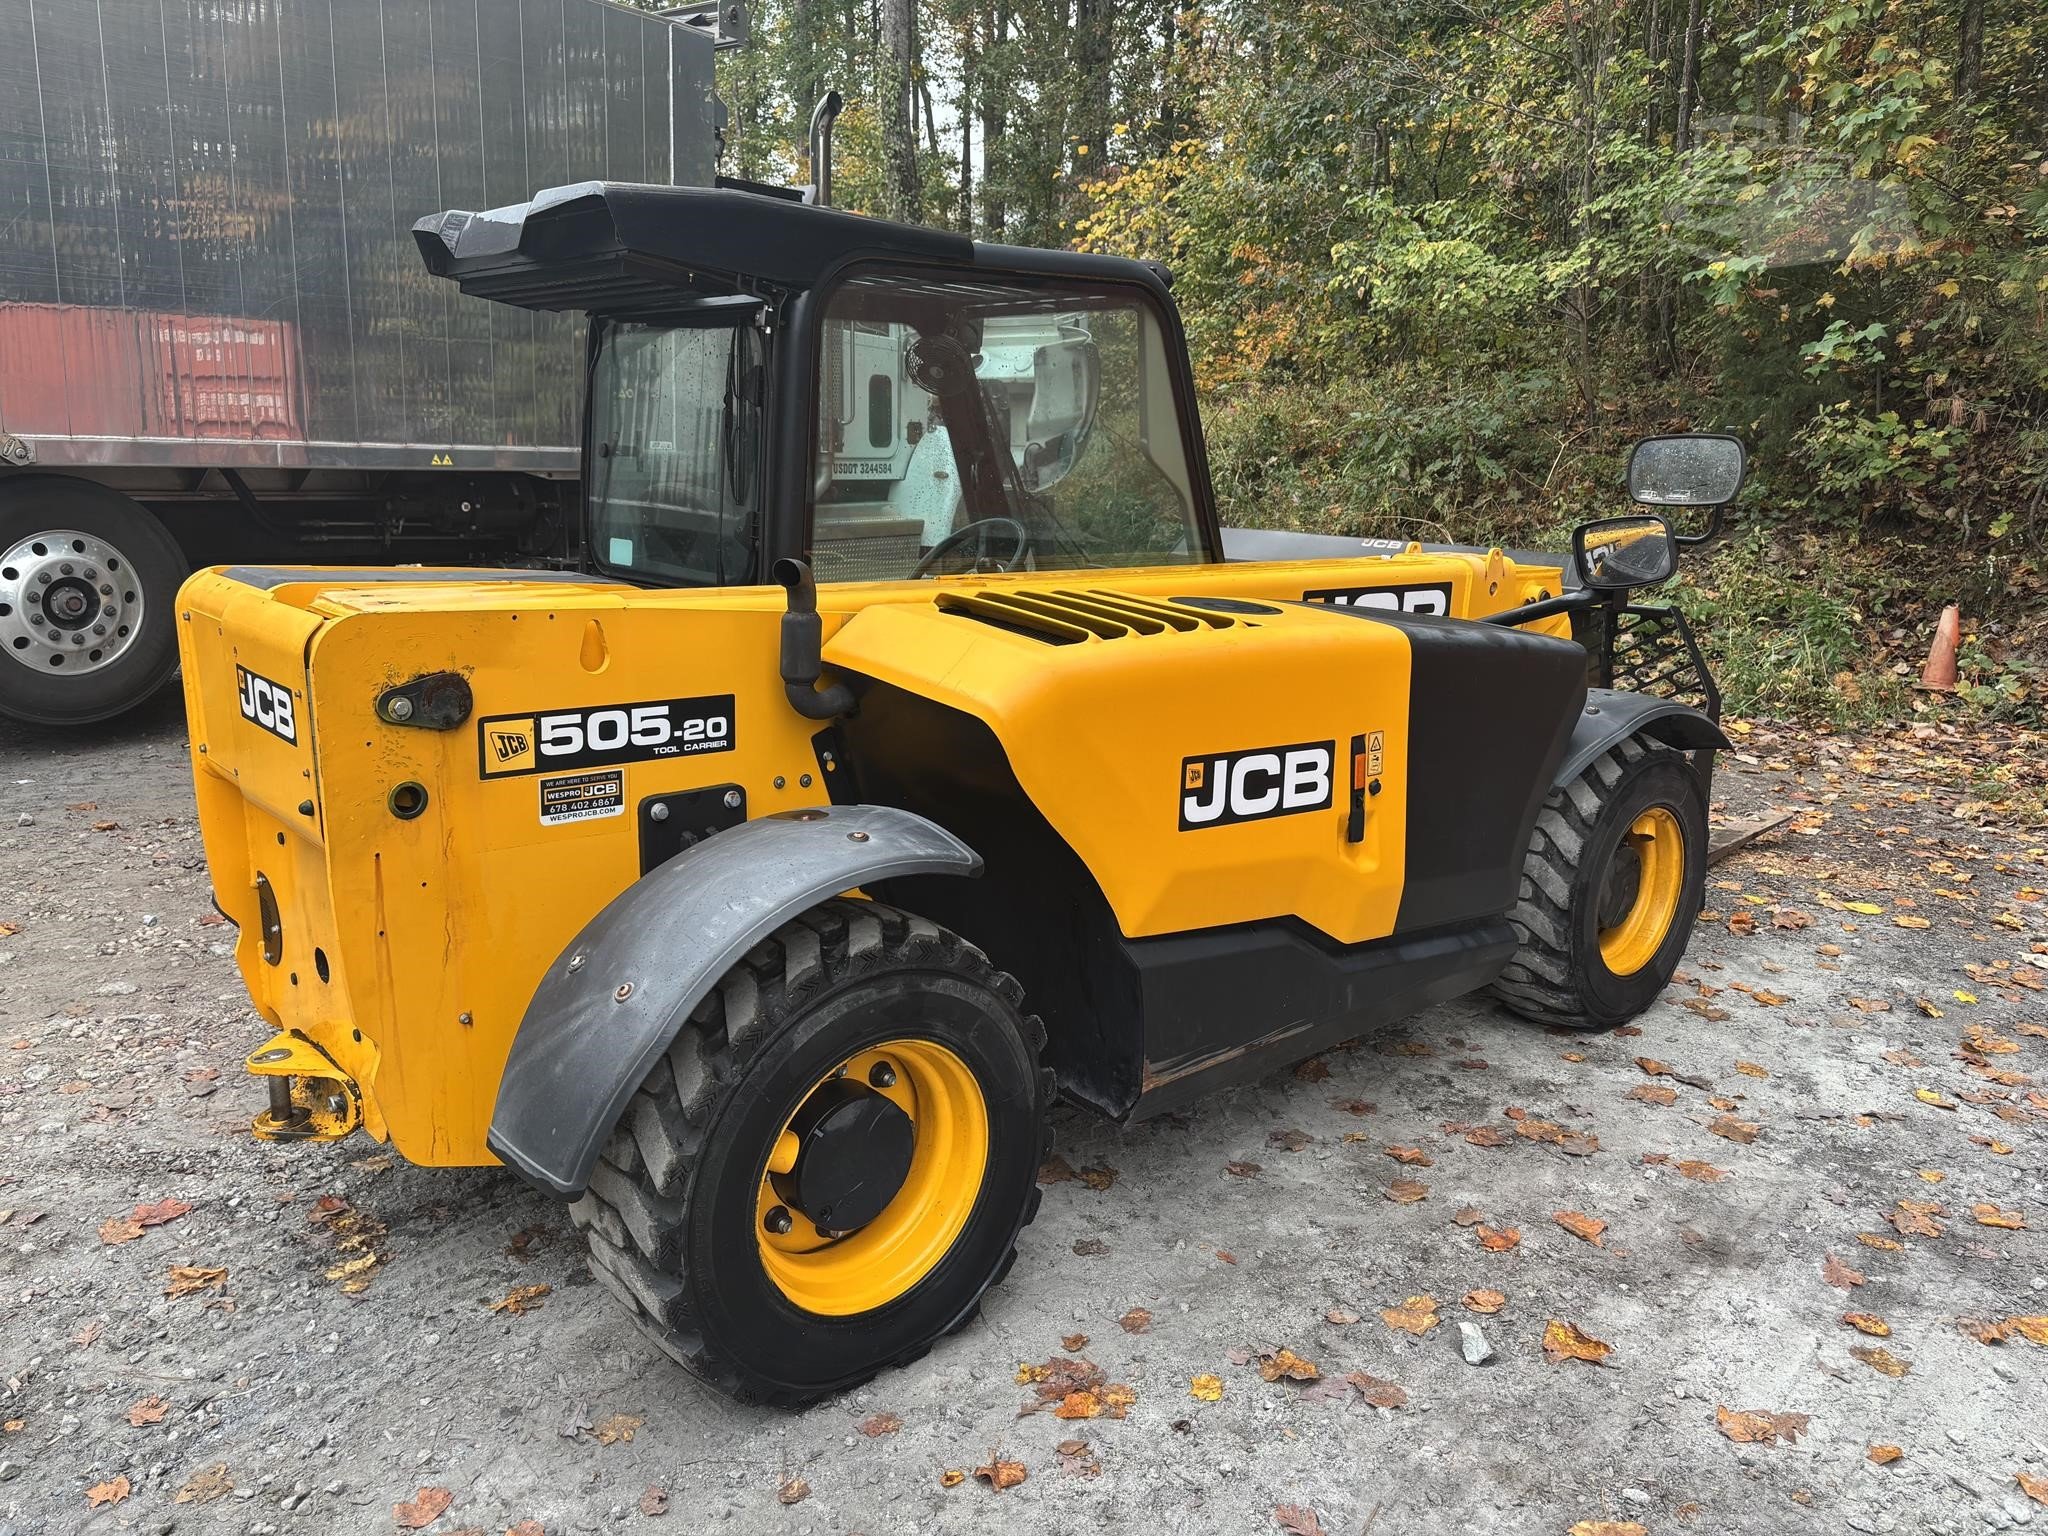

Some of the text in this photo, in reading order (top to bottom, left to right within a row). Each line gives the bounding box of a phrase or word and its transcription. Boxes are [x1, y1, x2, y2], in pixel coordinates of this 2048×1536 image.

[833, 463, 892, 474] USDOT 3244584
[1361, 538, 1404, 549] JCB
[240, 672, 295, 739] JCB
[496, 705, 728, 758] JCB 505-20
[653, 741, 728, 755] TOOL CARRIER
[547, 783, 617, 800] WESPRO JCB
[1184, 748, 1330, 823] JCB
[550, 797, 615, 813] 678.402.6867
[549, 807, 616, 822] WESPROJCB.COM
